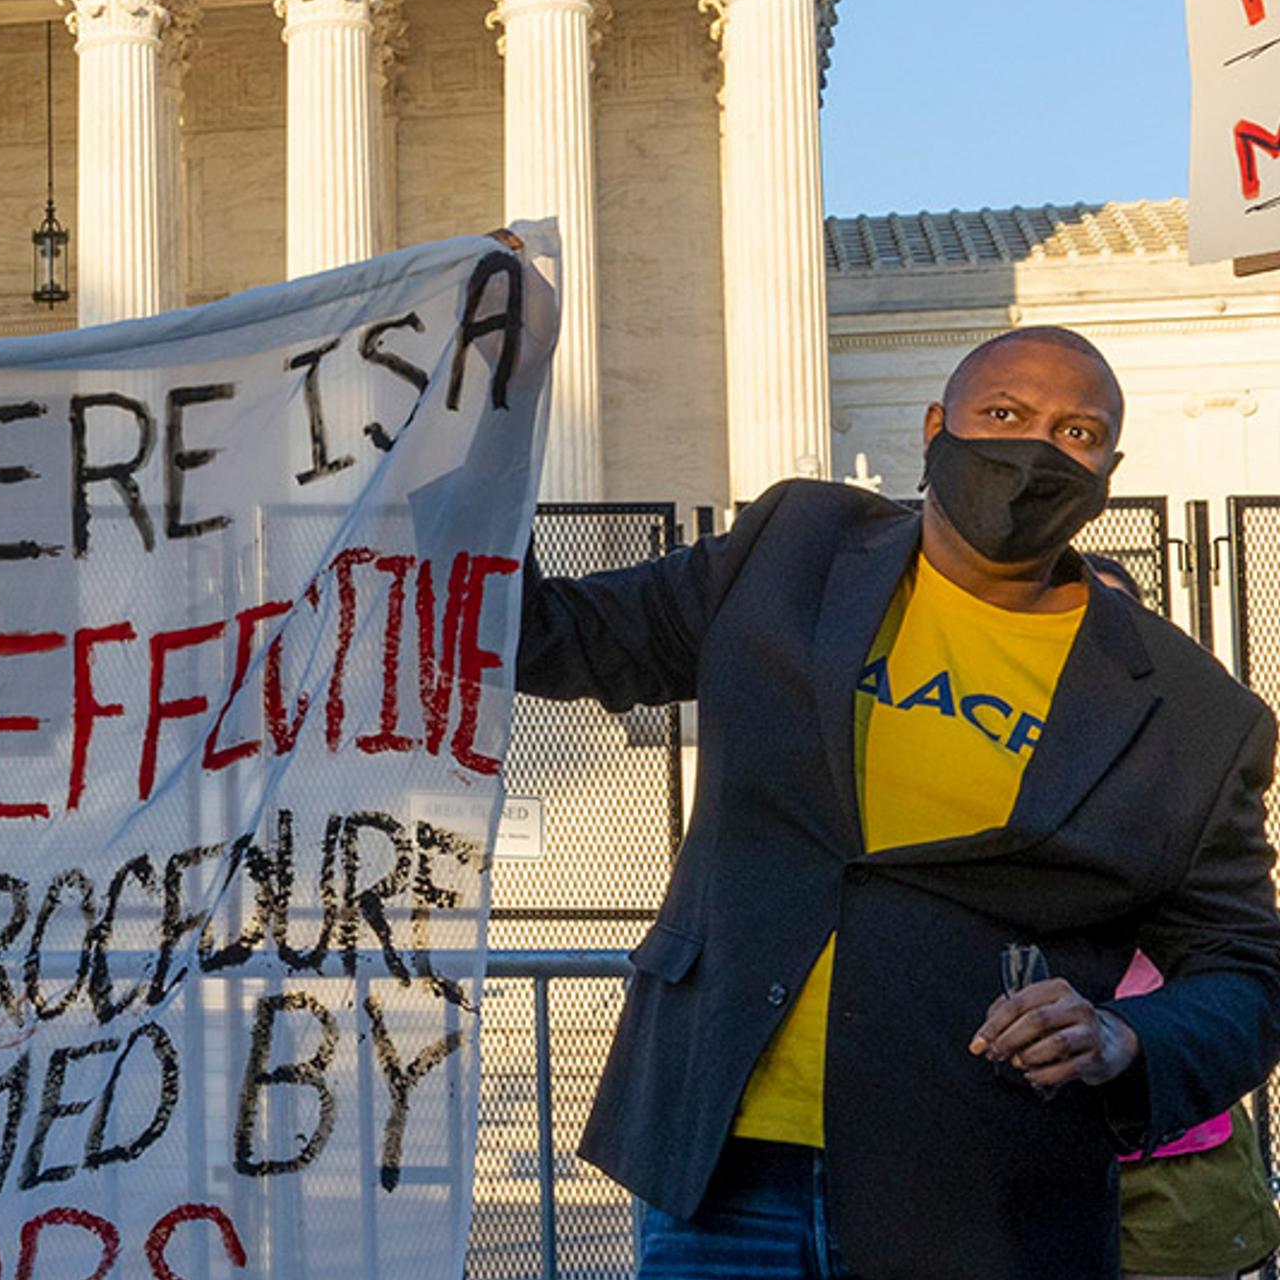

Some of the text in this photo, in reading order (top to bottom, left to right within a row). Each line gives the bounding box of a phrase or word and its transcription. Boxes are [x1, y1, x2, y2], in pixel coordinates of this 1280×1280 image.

[283, 312, 429, 486] IS
[446, 250, 523, 411] A
[856, 656, 1047, 755] AACP
[233, 990, 462, 1193] BY
